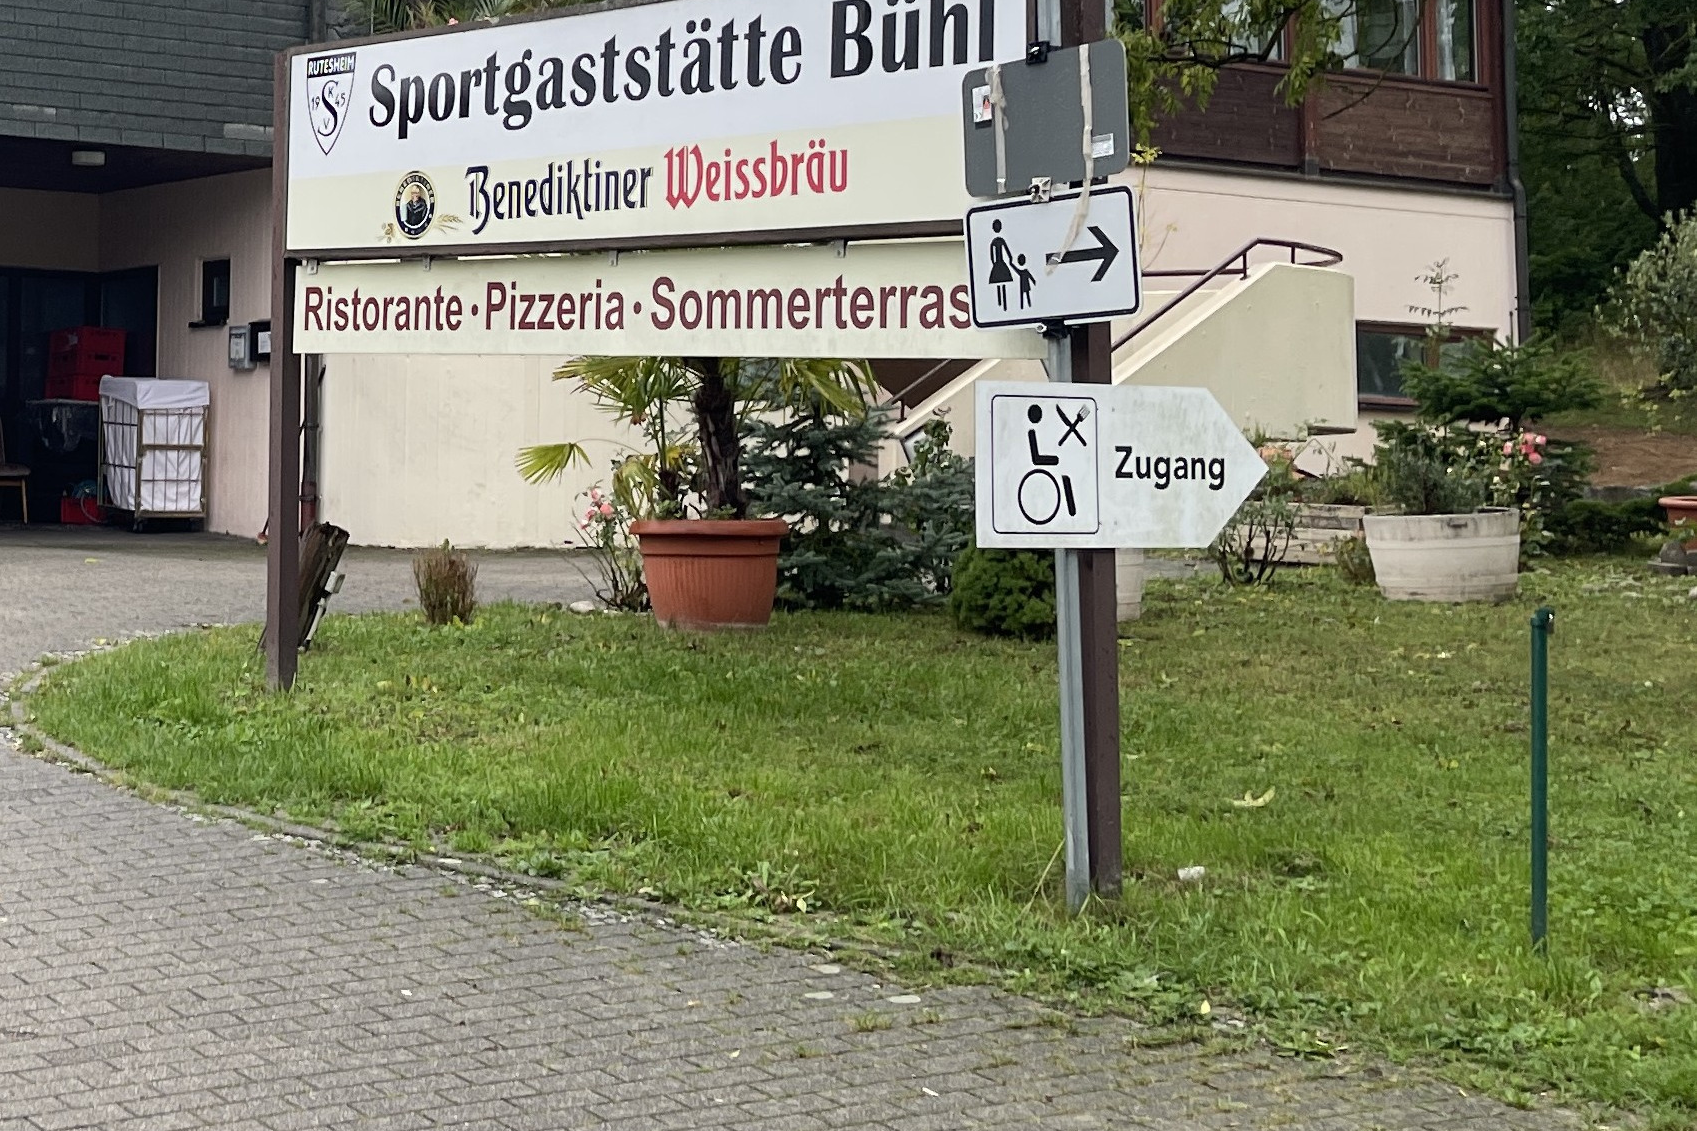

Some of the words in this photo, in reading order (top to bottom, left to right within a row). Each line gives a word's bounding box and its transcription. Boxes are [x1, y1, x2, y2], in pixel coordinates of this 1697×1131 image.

[308, 55, 354, 76] RUTESHEIM
[369, 13, 802, 140] Sportgaststätte
[464, 157, 653, 235] Benediktiner
[663, 139, 849, 210] Weissbräu
[304, 285, 462, 332] Ristorante
[485, 279, 625, 331] Pizzeria
[1114, 445, 1225, 491] Zugang
